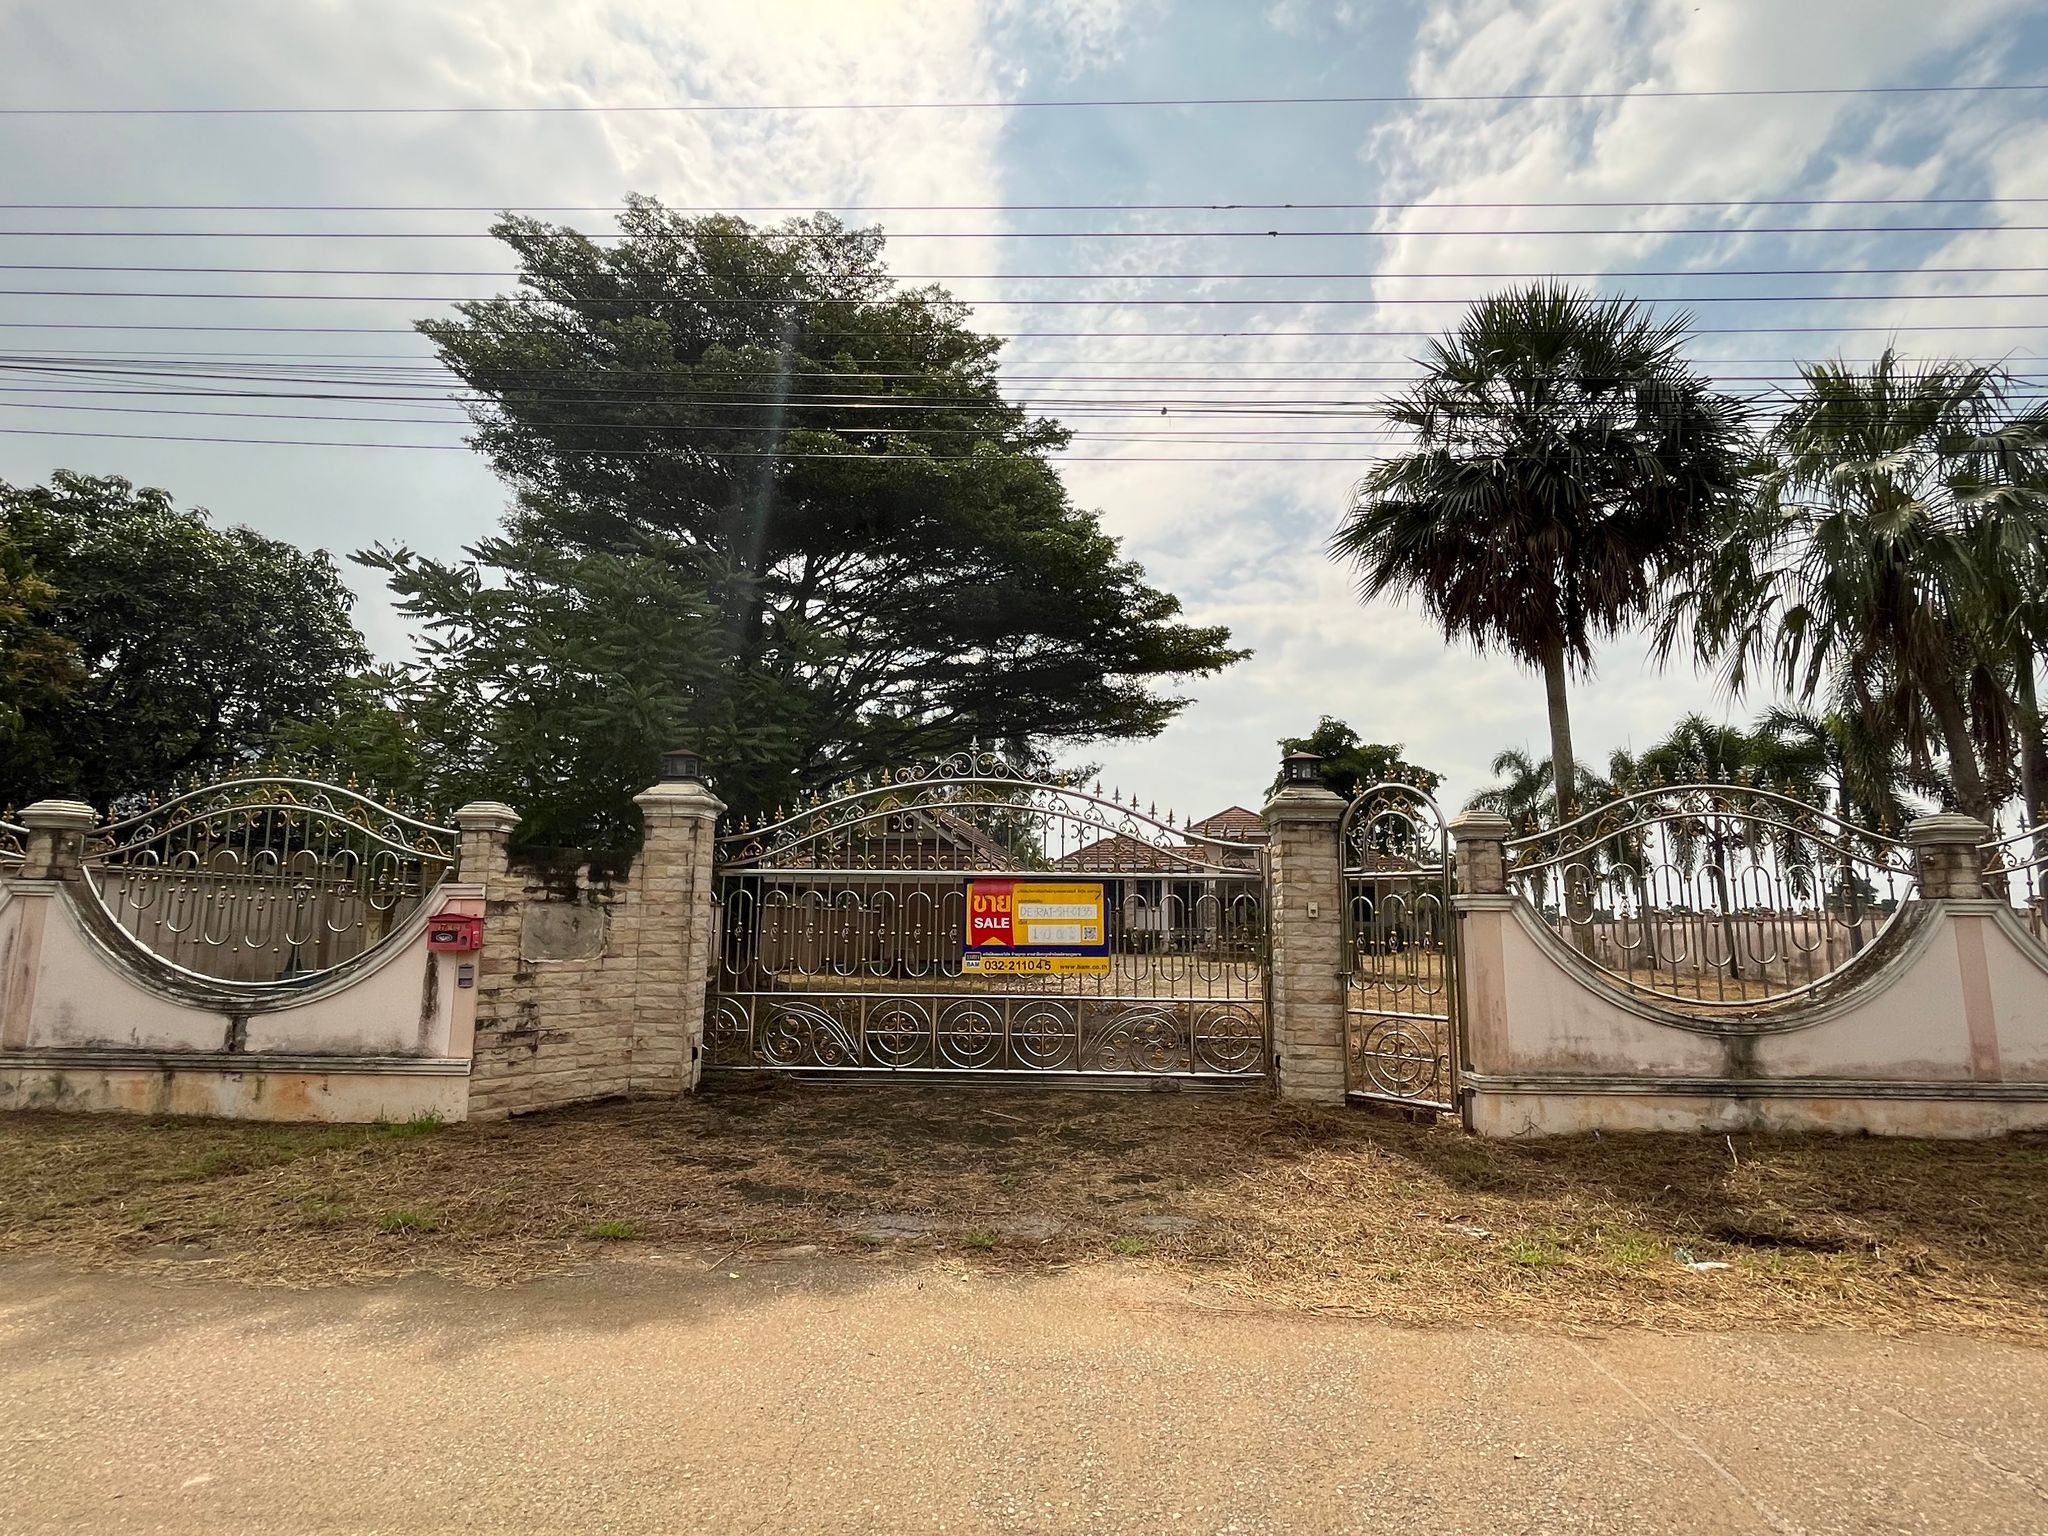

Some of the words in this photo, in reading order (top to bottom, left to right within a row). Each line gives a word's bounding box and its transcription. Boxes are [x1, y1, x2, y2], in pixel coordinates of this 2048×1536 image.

[973, 894, 1011, 913] ขาย
[974, 917, 1010, 929] SALE
[984, 960, 1052, 971] 032-211045
